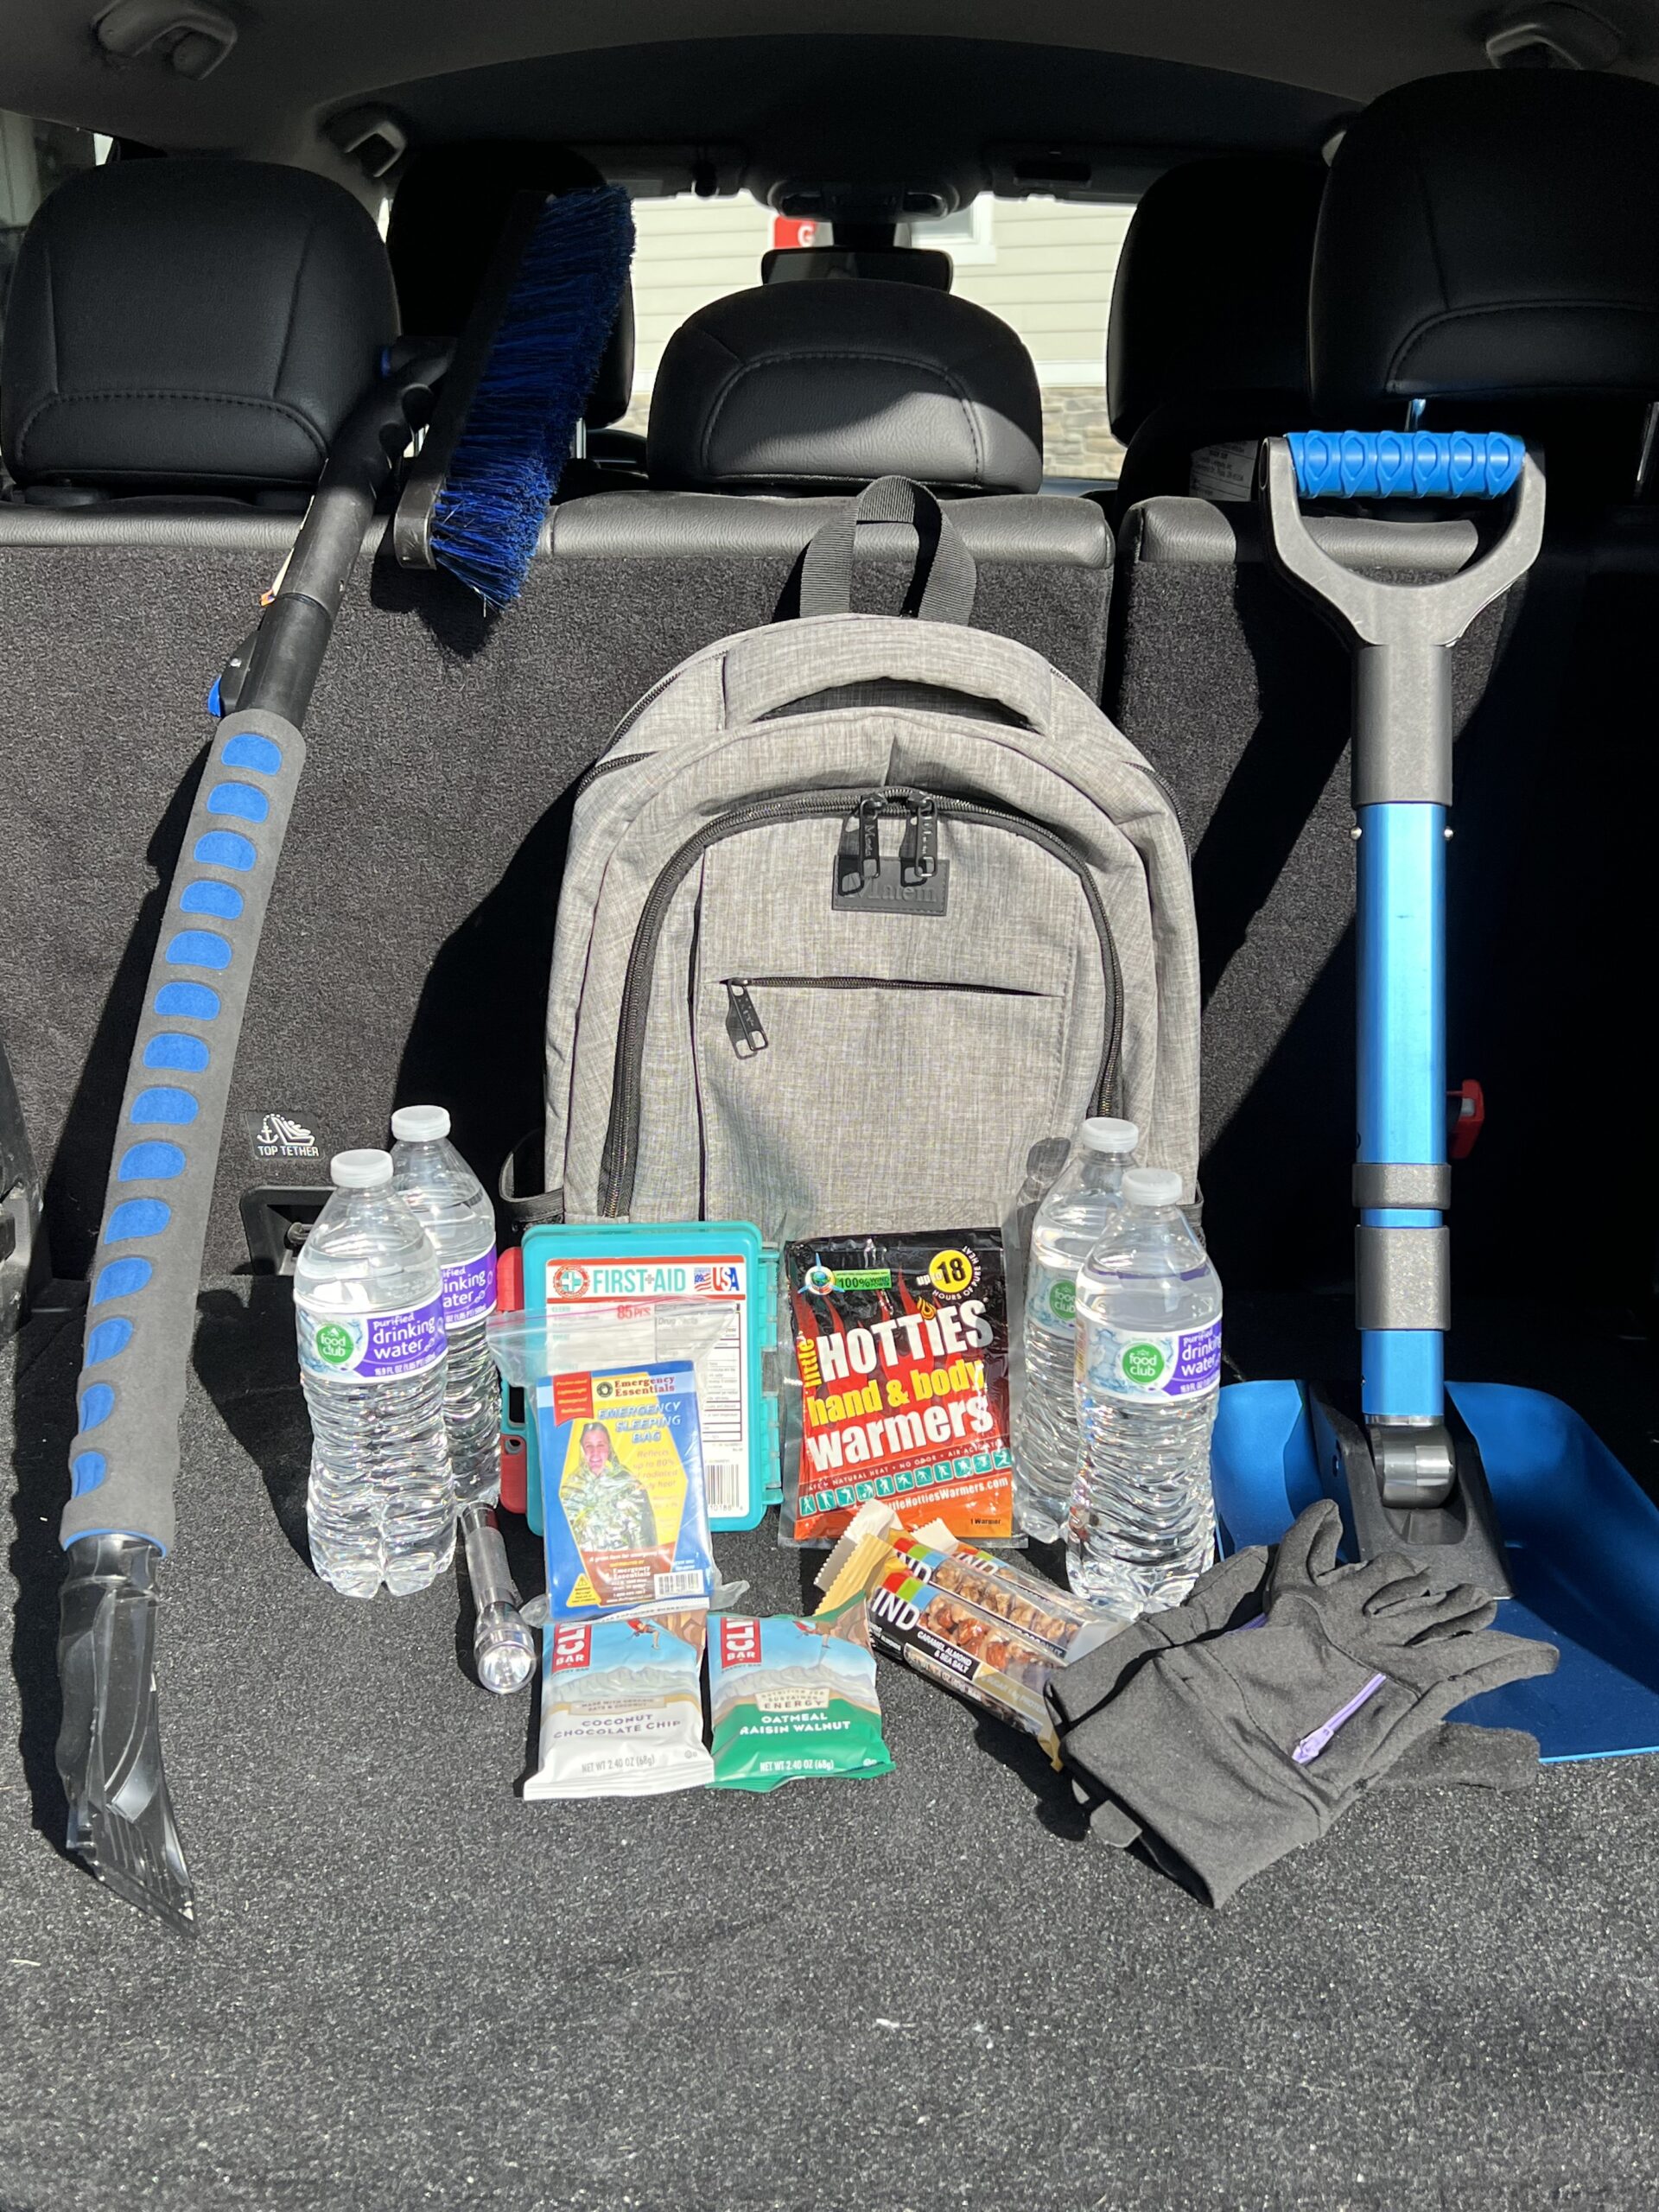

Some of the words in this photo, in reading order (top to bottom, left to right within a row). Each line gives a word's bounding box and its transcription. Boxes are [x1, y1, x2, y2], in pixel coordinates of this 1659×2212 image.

[257, 1146, 277, 1156] TOP
[279, 1146, 319, 1157] TETHER
[962, 1245, 980, 1264] HEAT
[593, 1268, 645, 1293] FIRST
[653, 1268, 686, 1292] AID
[713, 1267, 740, 1291] USA
[916, 1274, 931, 1286] up
[937, 1257, 966, 1284] 18
[443, 1270, 486, 1294] inking
[839, 1277, 870, 1288] 100%
[932, 1289, 962, 1300] HOURS
[963, 1287, 973, 1296] OF
[971, 1266, 981, 1287] PURE
[442, 1291, 474, 1308] ater
[1054, 1299, 1077, 1313] club
[372, 1313, 415, 1331] purified
[617, 1305, 632, 1320] 85
[321, 1332, 346, 1346] food
[372, 1316, 435, 1344] drinking
[1183, 1327, 1213, 1347] purified
[373, 1338, 423, 1359] water
[817, 1299, 994, 1382] HOTTIES
[322, 1345, 346, 1357] club
[1129, 1354, 1157, 1366] food
[798, 1337, 822, 1389] little
[1129, 1364, 1156, 1377] club
[1181, 1353, 1216, 1376] water
[614, 1376, 675, 1388] Emergency
[614, 1384, 675, 1397] Essentials
[807, 1380, 882, 1427] hand
[887, 1380, 910, 1408] &
[910, 1358, 987, 1402] body
[598, 1401, 681, 1420] EMERGENCY
[615, 1414, 681, 1433] SLEEPING
[632, 1431, 662, 1443] BAG
[807, 1395, 995, 1472] warmers
[832, 1472, 867, 1485] NATURAL
[869, 1466, 888, 1477] HEAT
[914, 1454, 937, 1465] ODOR
[957, 1552, 999, 1576] IND
[871, 1588, 920, 1631] IND
[556, 1624, 585, 1656] CLI
[726, 1618, 755, 1651] CLI
[727, 1651, 756, 1661] BAR
[917, 1630, 946, 1651] CARAMEL
[944, 1646, 972, 1666] ALMOND
[556, 1654, 585, 1666] BAR
[940, 1653, 953, 1664] SEA
[951, 1659, 969, 1673] SALT
[764, 1700, 822, 1709] ENERGY
[582, 1714, 653, 1727] COCONUT
[740, 1725, 790, 1735] RAISIN
[792, 1720, 851, 1732] WALNUT
[760, 1713, 828, 1724] OATMEAL
[553, 1724, 642, 1738] CHOCOLATE
[645, 1720, 681, 1730] CHIP
[582, 1762, 594, 1772] NET
[595, 1761, 606, 1771] WT
[607, 1758, 623, 1770] 2.40
[625, 1757, 635, 1767] OZ
[636, 1754, 655, 1767] (68g)
[760, 1761, 773, 1771] NET
[774, 1760, 785, 1771] WT
[785, 1760, 802, 1770] 2.40
[804, 1758, 813, 1770] OZ
[815, 1758, 835, 1771] (68g)
